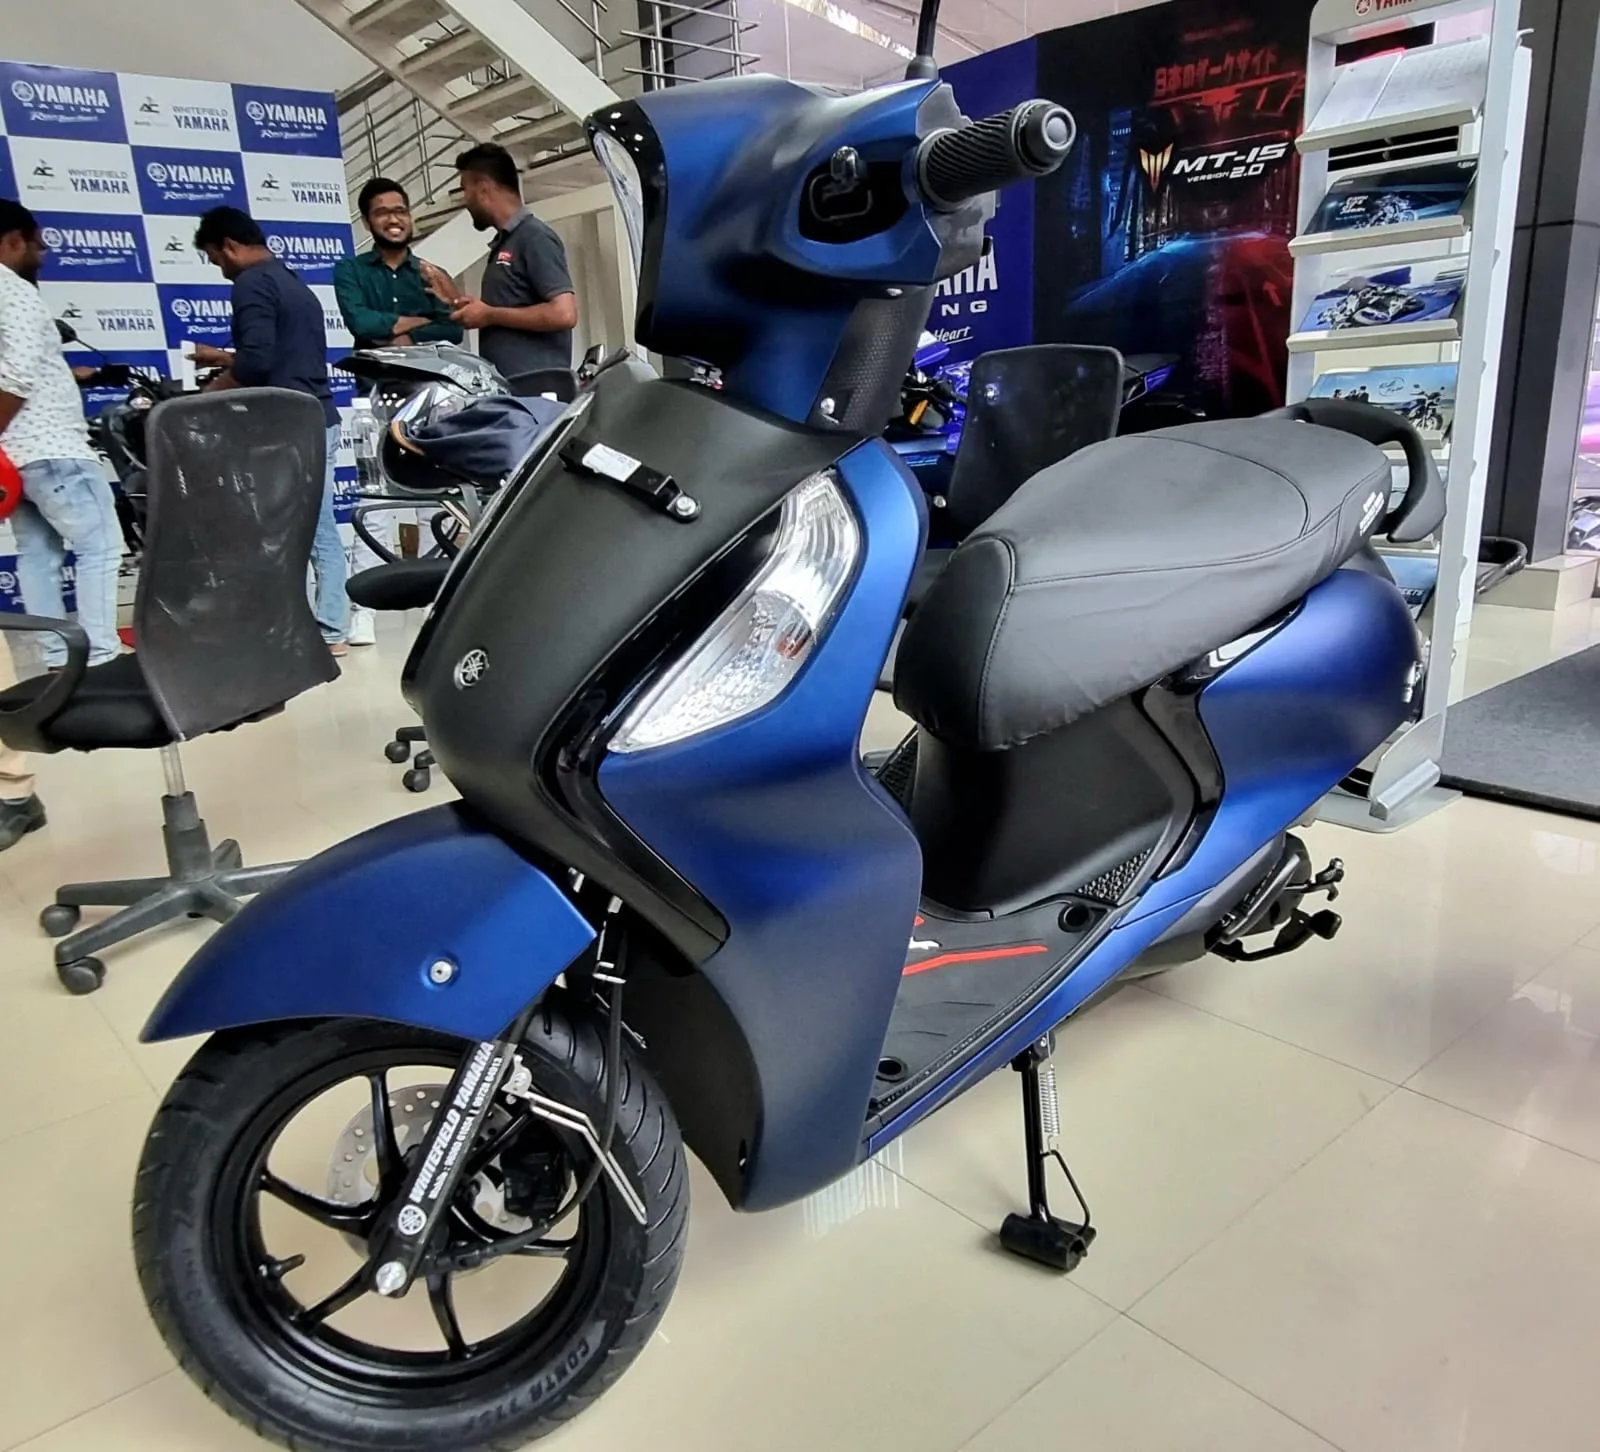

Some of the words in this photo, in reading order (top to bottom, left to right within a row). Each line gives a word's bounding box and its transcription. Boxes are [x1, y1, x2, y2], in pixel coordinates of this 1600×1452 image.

[33, 83, 110, 108] YAMAHA
[172, 105, 228, 117] WHITEFIELD
[263, 103, 327, 124] YAMAHA
[173, 115, 230, 132] YAMAHA
[68, 168, 128, 179] WHITEFIELD
[166, 164, 235, 185] YAMAHA
[1187, 171, 1230, 183] VERSION
[1229, 162, 1265, 179] 2.0
[70, 178, 130, 194] YAMAHA
[290, 181, 341, 190] WHITEFIELD
[291, 189, 342, 204] YAMAHA
[61, 229, 137, 249] YAMAHA
[284, 236, 345, 254] YAMAHA
[190, 300, 234, 316] YAMA
[97, 318, 156, 331] YAMAHA
[409, 1108, 461, 1203] WHITEFIELD
[453, 1041, 495, 1110] YAMAHA
